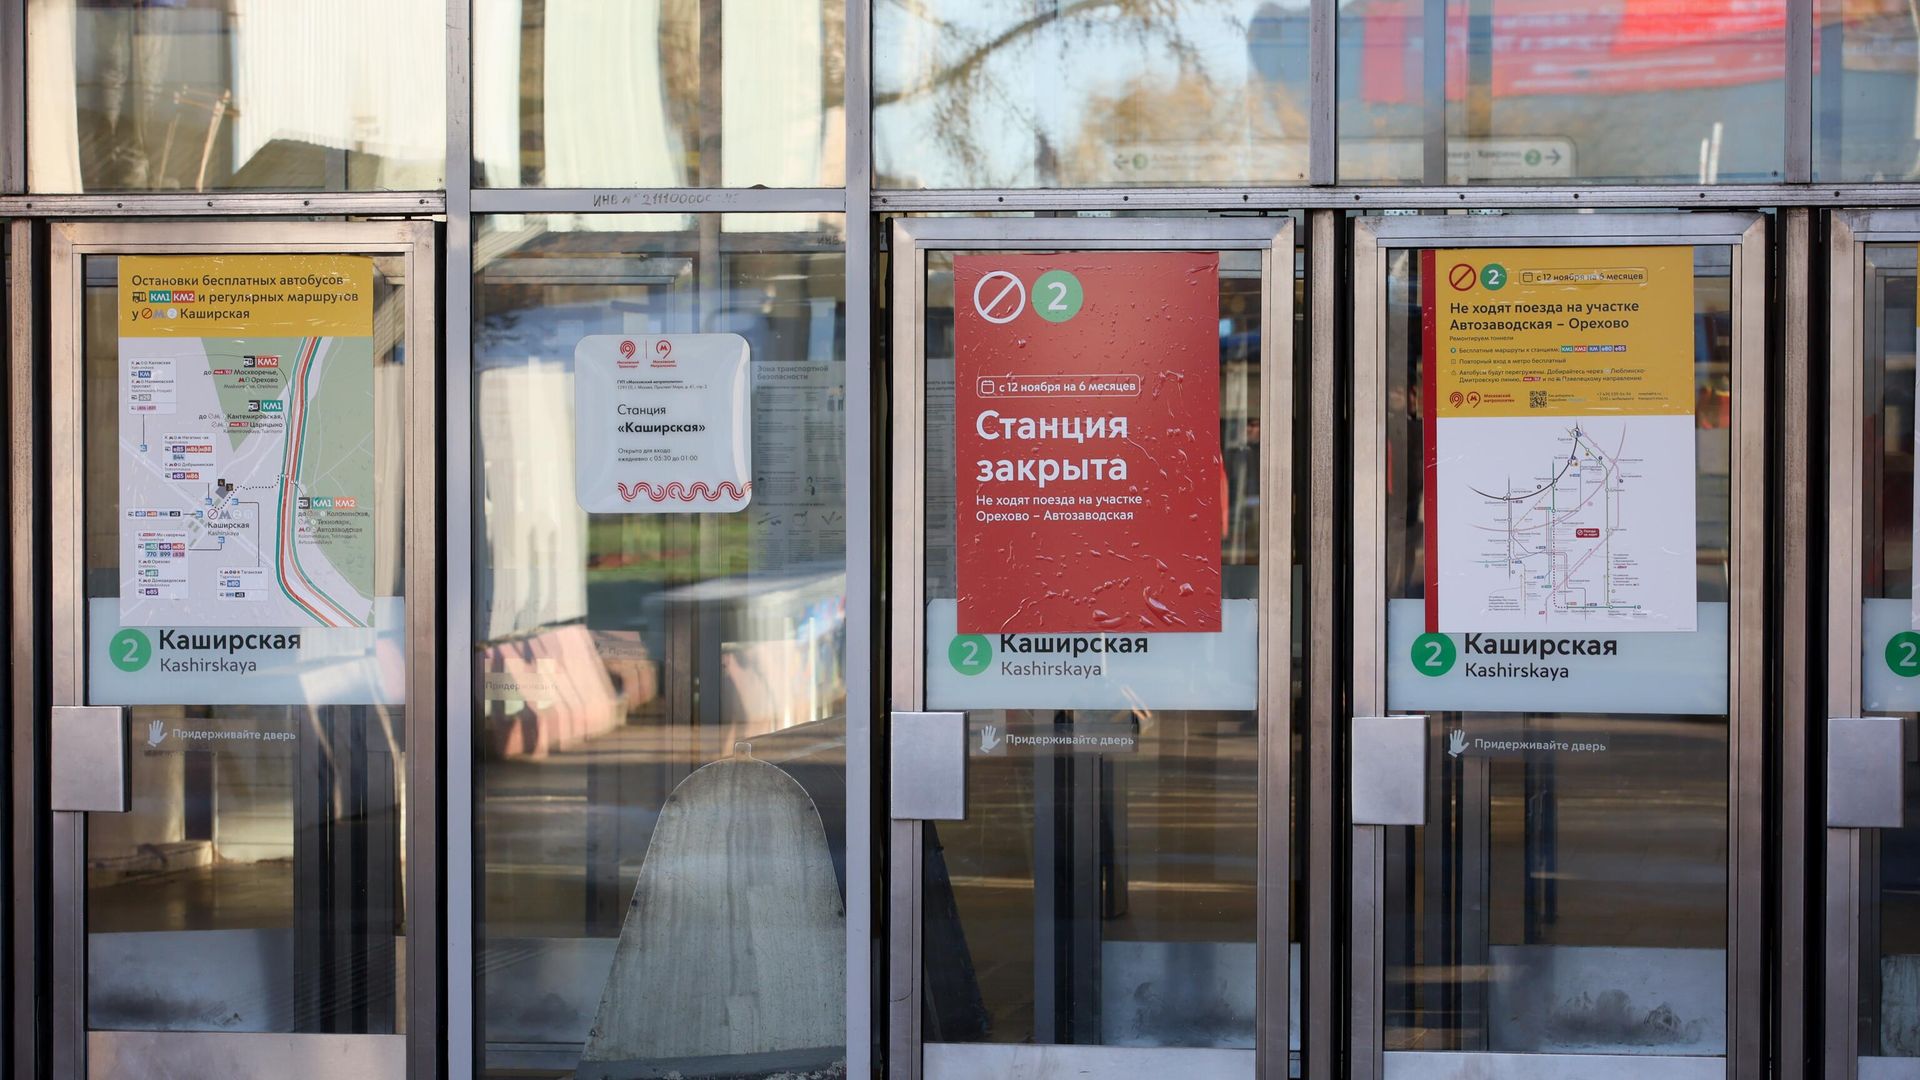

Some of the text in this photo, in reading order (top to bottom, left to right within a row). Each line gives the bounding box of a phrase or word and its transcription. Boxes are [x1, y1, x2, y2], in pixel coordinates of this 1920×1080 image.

[132, 275, 344, 287] Остановки бесплатных автобусов
[1488, 269, 1500, 284] 2
[1543, 273, 1552, 282] 12
[1554, 274, 1584, 283] ноября
[1606, 272, 1643, 282] месяцев
[150, 293, 359, 304] КМ1 КМ2 и регулярных маршрутов
[1047, 281, 1068, 310] 2
[132, 308, 250, 321] у Каширская
[1450, 302, 1640, 317] Не ходят поезда на участке
[1450, 318, 1552, 332] Автозаводская
[1569, 318, 1629, 332] Орехово
[257, 358, 278, 366] КМ2
[999, 381, 1136, 394] с 12 ноября на 6 месяцев
[617, 404, 666, 416] Станция
[618, 422, 706, 436] «Каширская»
[976, 409, 1129, 444] Станция
[618, 448, 642, 456] Открыто
[976, 456, 1128, 488] закрыта
[976, 494, 1142, 508] Не ходят поезда на участке
[976, 511, 1030, 524] Орехово
[1044, 510, 1134, 523] Автозаводская
[122, 630, 301, 662] 2 Каширская
[961, 634, 1148, 666] 2 Каширская
[1425, 632, 1617, 666] 2 Каширская
[1899, 641, 1917, 666] 2
[161, 658, 257, 675] Kashirskaya
[1001, 661, 1102, 678] Kashirskaya
[1465, 662, 1568, 681] Kashirskaya
[172, 728, 296, 742] Придерживайте дверь
[1006, 734, 1134, 747] Придерживайте дверь
[1474, 739, 1606, 752] Придерживайте дверь
